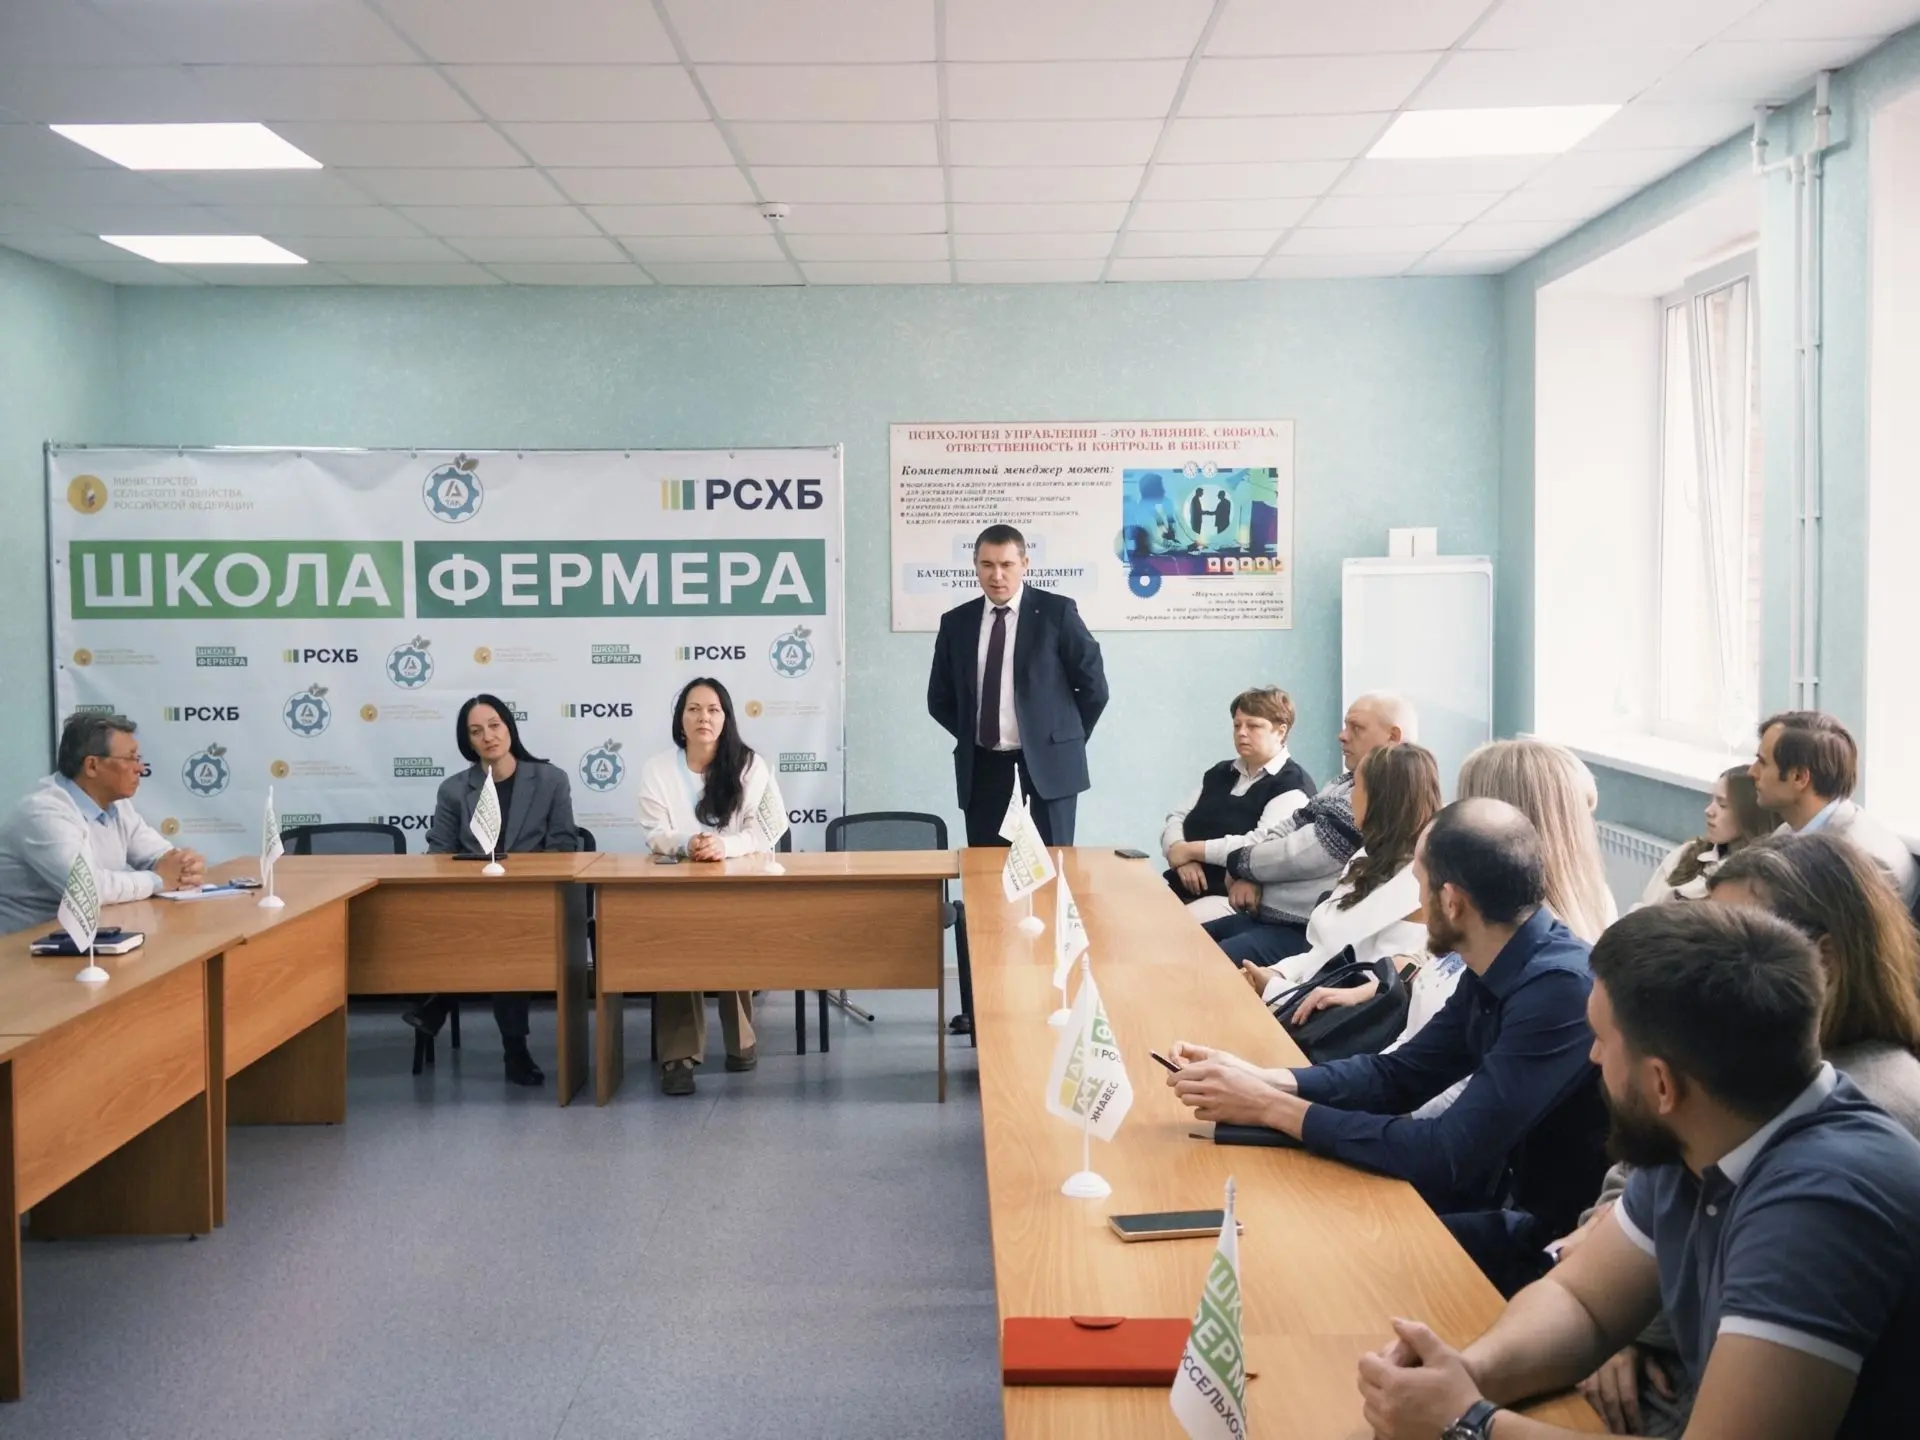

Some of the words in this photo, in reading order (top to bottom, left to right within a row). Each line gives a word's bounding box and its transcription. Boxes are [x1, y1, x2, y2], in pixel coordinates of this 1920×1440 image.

[909, 430, 999, 441] ПСИХОЛОГИЯ
[1005, 429, 1097, 440] УПРАВЛЕНИЯ
[1111, 429, 1135, 439] ЭТО
[946, 443, 1073, 453] ОТВЕТСТВЕННОСТЬ
[1078, 442, 1087, 452] И
[1092, 442, 1163, 452] КОНТРОЛЬ
[1168, 441, 1176, 451] В
[1181, 440, 1241, 451] БИЗНЕСЕ
[902, 464, 999, 477] Компетентный
[1003, 467, 1063, 477] менеджер
[1067, 467, 1115, 475] может:
[705, 478, 824, 511] РСХБ
[82, 552, 391, 607] ШКОЛА
[428, 551, 813, 606] ФЕРМЕРА
[197, 647, 235, 656] ШКОЛА
[592, 645, 629, 653] ШКОЛА
[694, 646, 746, 660] РСХБ
[197, 657, 247, 666] ФЕРМЕРА
[303, 649, 359, 663] РСХБ
[592, 655, 641, 663] ФЕРМЕРА
[184, 706, 240, 721] РСХБ
[580, 703, 634, 718] РСХБ
[394, 758, 432, 766] ШКОЛА
[780, 753, 816, 761] ШКОЛА
[395, 768, 443, 776] ФЕРМЕРА
[780, 762, 827, 771] ФЕРМЕРА
[282, 814, 321, 823] ШКОЛА
[388, 815, 435, 830] РСХ
[786, 809, 827, 824] СХБ
